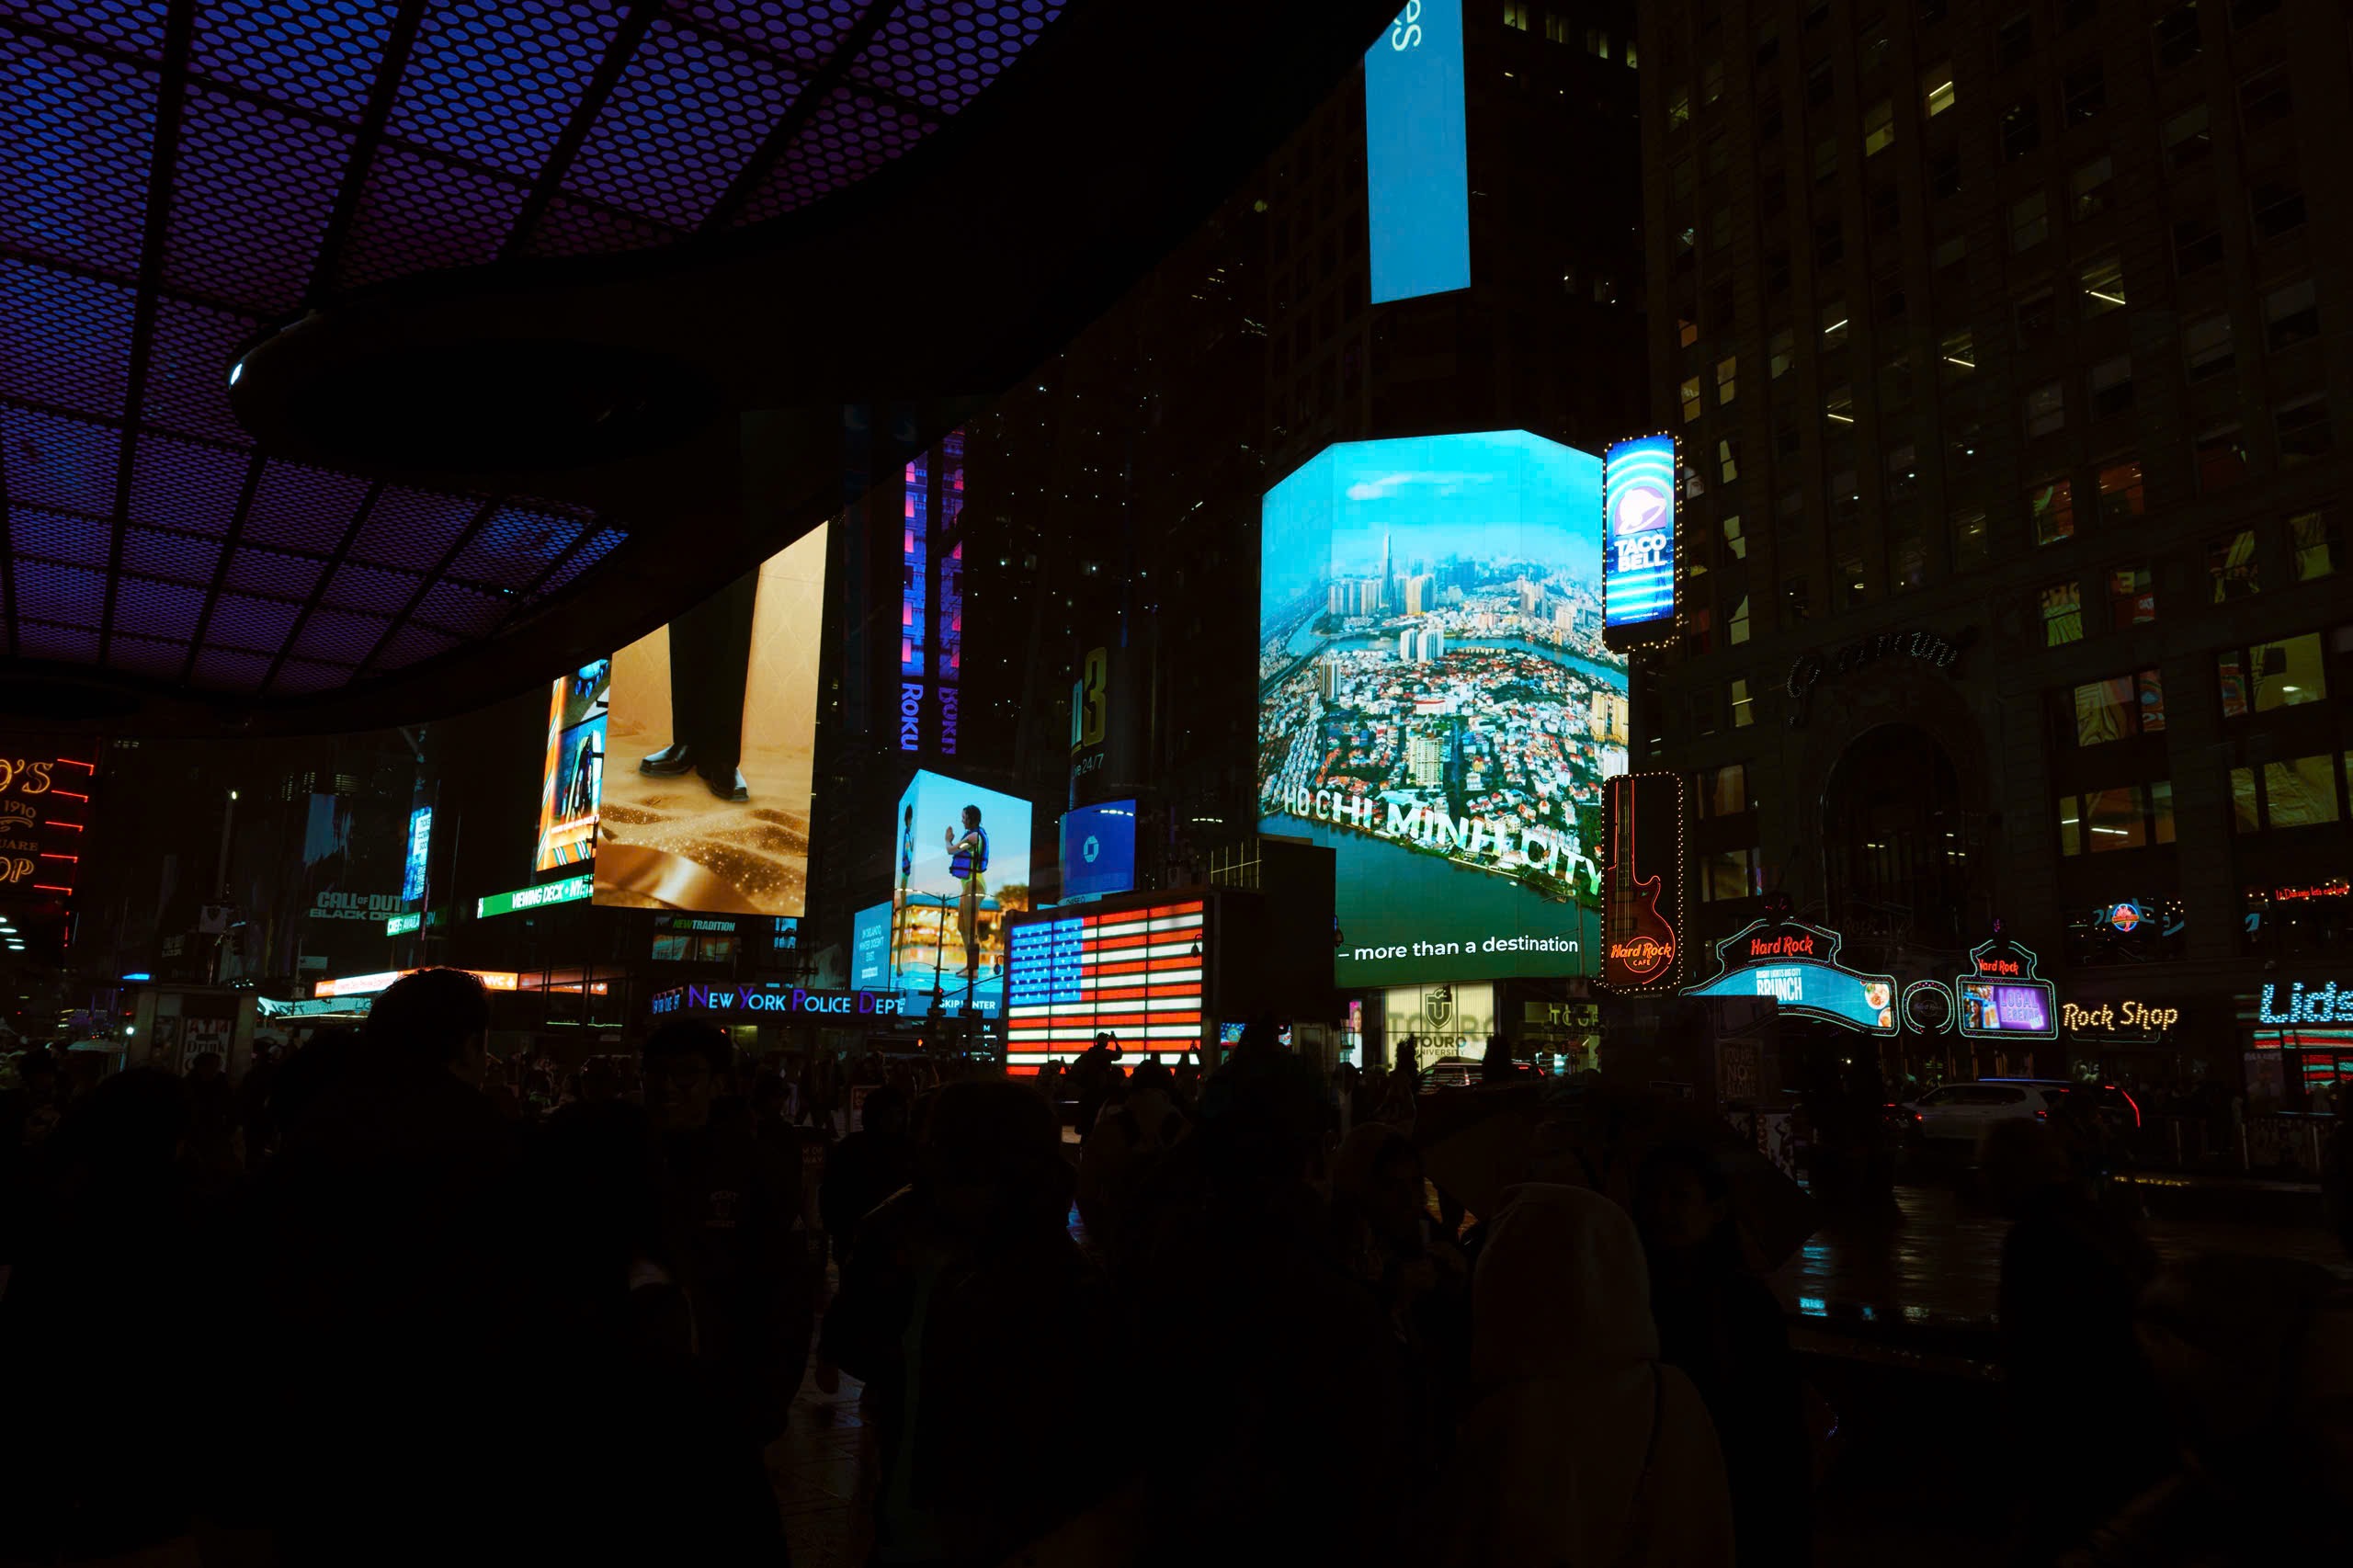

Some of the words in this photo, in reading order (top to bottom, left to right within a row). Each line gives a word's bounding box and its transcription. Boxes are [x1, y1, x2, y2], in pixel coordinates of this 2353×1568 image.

[1614, 533, 1667, 556] TACO
[1618, 551, 1666, 573] BELL
[3, 800, 37, 818] 1910
[1285, 787, 1311, 816] HO
[1315, 790, 1373, 829] CHI
[1386, 802, 1506, 856] MINH
[1520, 832, 1602, 895] CITY
[317, 891, 359, 909] CALL
[358, 896, 369, 905] OF
[369, 893, 410, 913] DUT
[512, 889, 542, 909] VIEWING
[542, 883, 564, 903] DECK
[309, 908, 368, 920] BLACK
[1354, 943, 1407, 960] more
[1412, 939, 1460, 958] than
[1465, 941, 1477, 954] a
[1482, 935, 1578, 954] destination
[1610, 943, 1642, 959] Hard
[1643, 942, 1673, 959] Rock
[1751, 937, 1781, 956] Hard
[1783, 934, 1813, 957] Rock
[1999, 960, 2019, 975] Rock
[688, 984, 734, 1009] NEW
[738, 986, 786, 1011] YORK
[791, 988, 851, 1013] POLICE
[1756, 977, 1802, 1001] BRUNCH
[1998, 988, 2039, 1008] LOCAL
[2259, 980, 2353, 1024] Lids
[2062, 1003, 2115, 1031] Rock
[2120, 1000, 2178, 1031] Shop
[1414, 1036, 1466, 1048] TOURO
